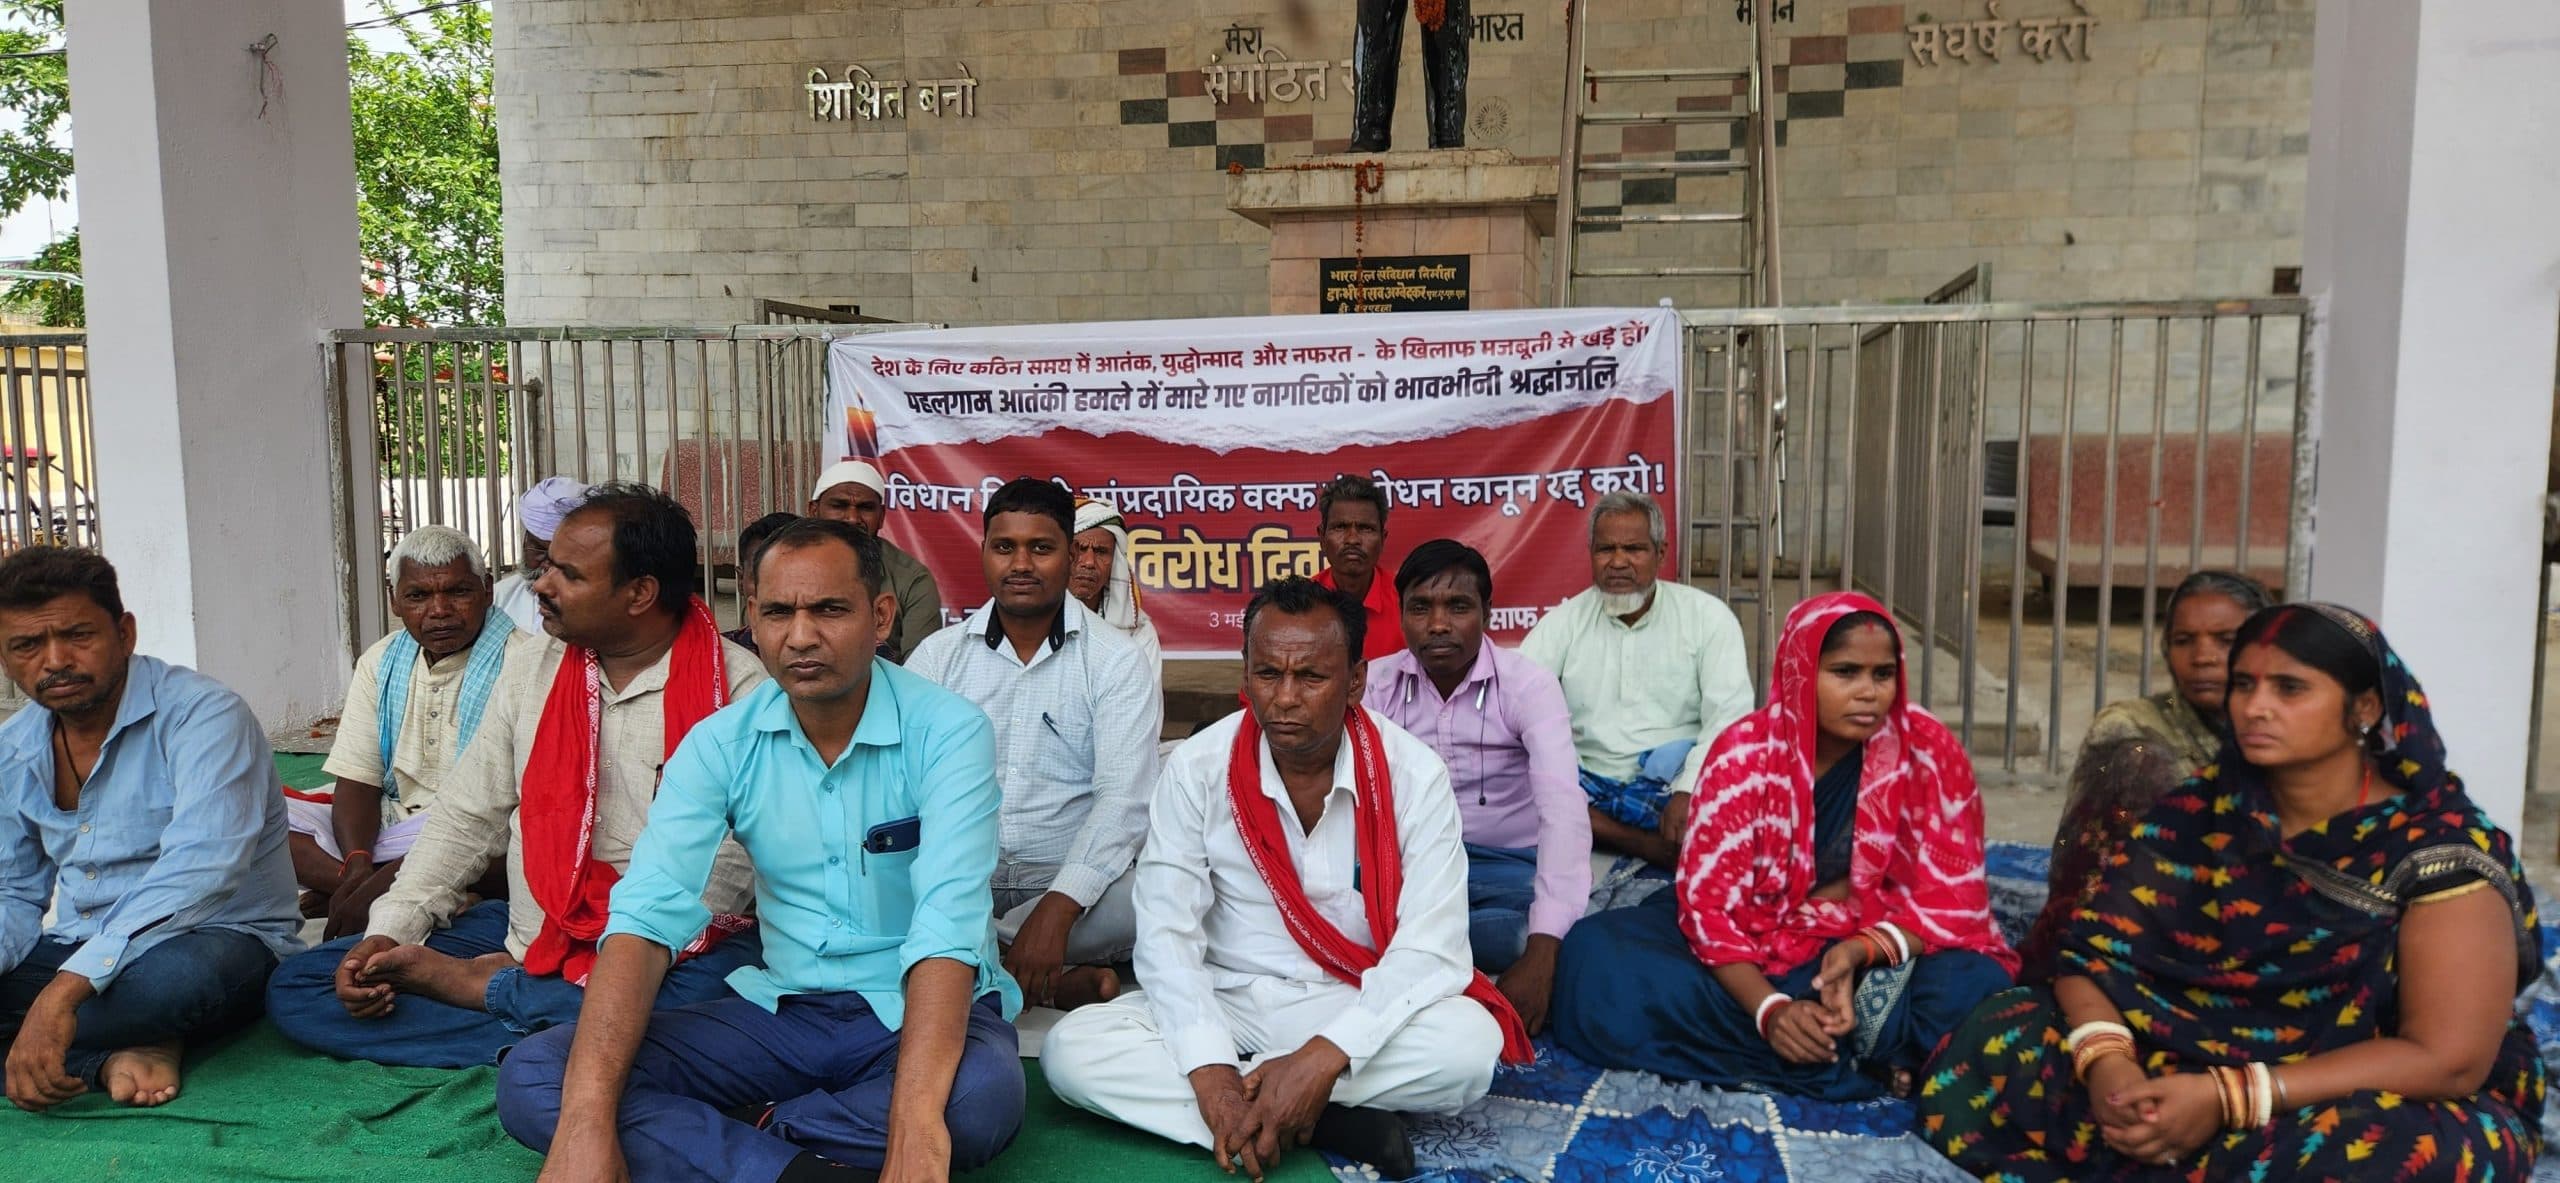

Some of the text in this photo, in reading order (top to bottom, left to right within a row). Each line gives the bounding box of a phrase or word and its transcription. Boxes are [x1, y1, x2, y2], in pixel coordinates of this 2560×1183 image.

[1222, 23, 1265, 55] मेरा
[1736, 0, 1795, 25] मान
[804, 61, 979, 121] शिक्षित बनो
[1201, 44, 1331, 105] संगठित
[871, 354, 901, 377] देश
[905, 356, 923, 376] के
[927, 358, 966, 375] लिए
[969, 355, 1024, 375] कठिन
[1026, 357, 1071, 375] समय
[1075, 352, 1092, 373] में
[1095, 350, 1158, 374] आतंक,
[1161, 347, 1244, 377] युद्धोन्माद
[1253, 342, 1288, 367] और
[1292, 343, 1353, 365] नफरत
[1376, 338, 1396, 361] के
[1400, 338, 1476, 360] खिलाफ
[1480, 331, 1553, 360] मजबूती
[1558, 330, 1576, 349] से
[1581, 326, 1617, 350] खड़े
[904, 355, 1619, 415] पहलगाम आतंकी हमले में मारे गए नागरिकों को भावभीनी श्रद्धांजलि
[884, 473, 975, 512] विधान
[1081, 473, 1237, 518] सांप्रदायिक
[1242, 482, 1317, 511] वक्फ
[1450, 474, 1541, 516] कानून
[1545, 469, 1585, 508] रद्द
[1590, 454, 1666, 494] करो!
[1128, 527, 1330, 589] विरोध दिव
[1209, 608, 1247, 630] 3 मई
[1489, 606, 1539, 630] साफ
